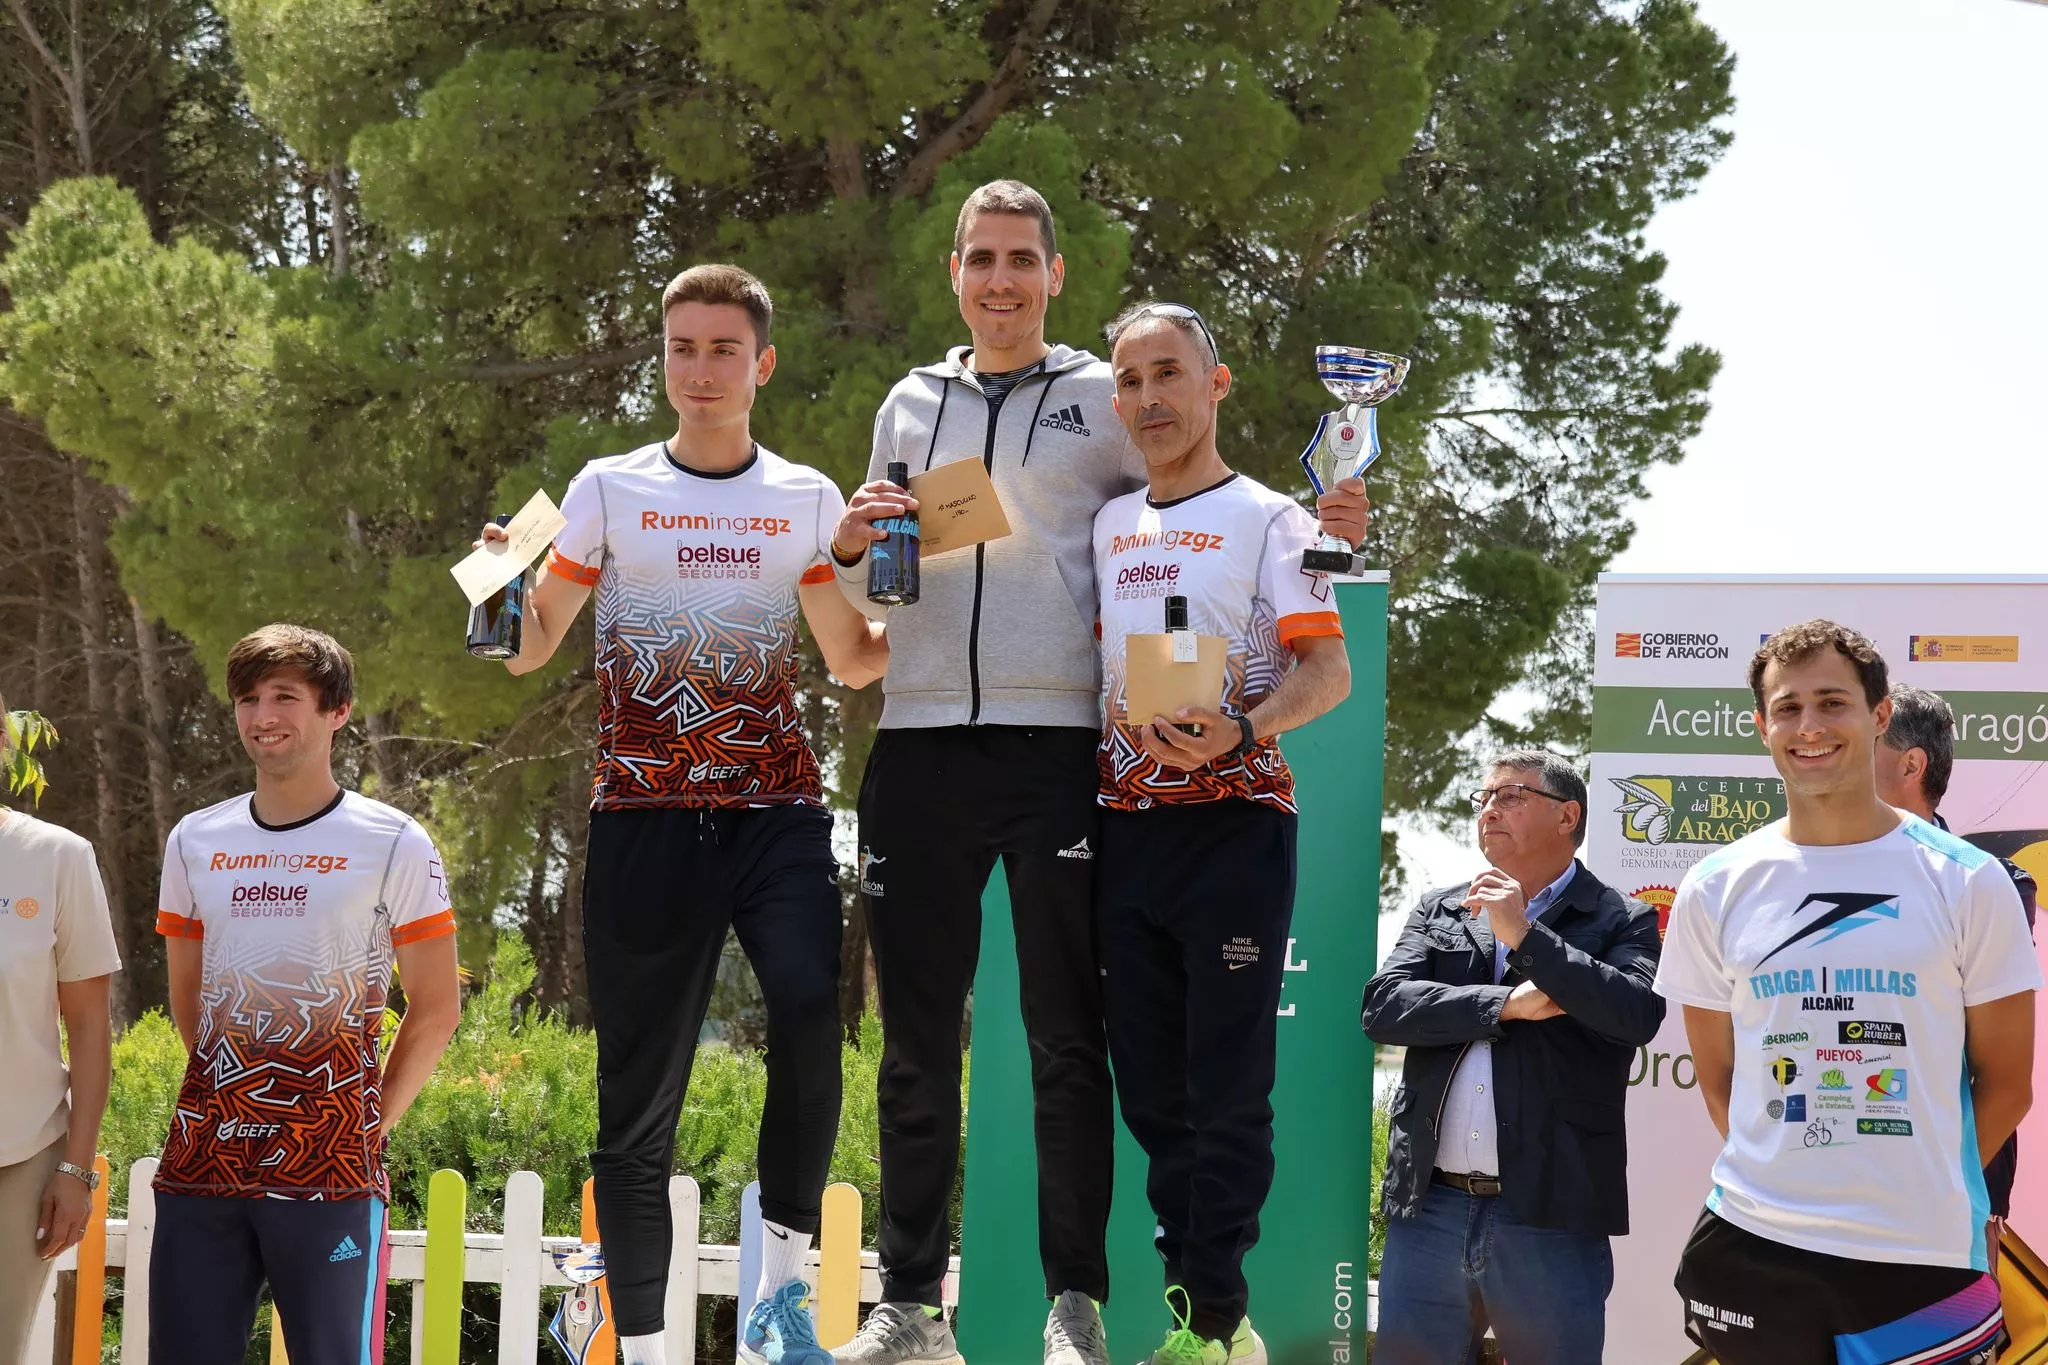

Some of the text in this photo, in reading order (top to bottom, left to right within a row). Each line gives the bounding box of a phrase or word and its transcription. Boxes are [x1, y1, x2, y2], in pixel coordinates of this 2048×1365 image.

[1039, 418, 1091, 437] adidas
[641, 511, 792, 537] Runningzgz
[1109, 530, 1225, 558] Runningzgz
[678, 568, 761, 580] SEGUROS
[1113, 586, 1176, 602] SEGUROS
[1642, 632, 1719, 646] GOBIERNO
[1642, 646, 1729, 659] DE ARAGON
[1647, 698, 1755, 738] Aceite
[708, 764, 751, 780] GEFF
[1677, 780, 1785, 795] ACEITE
[1691, 799, 1709, 812] del
[1621, 847, 1667, 859] CONSEJO
[209, 849, 349, 874] Runningzgz
[230, 906, 306, 918] SEGUROS
[1232, 936, 1252, 945] NIKE
[1222, 944, 1260, 954] RUNNING
[1222, 952, 1259, 962] DIVISION
[1749, 967, 1917, 1000] TRAGA MILLAS
[1801, 995, 1854, 1011] ALCAÑIZ
[1863, 1022, 1893, 1032] SPAIN
[1863, 1030, 1902, 1041] RUBBER
[1815, 1048, 1863, 1062] PUEYOS
[1817, 1094, 1852, 1103] Camping
[236, 1123, 281, 1138] GEFF
[329, 1248, 362, 1263] adidas
[1328, 1261, 1353, 1365] al.com
[1689, 1299, 1755, 1329] TRAGA MILLAS
